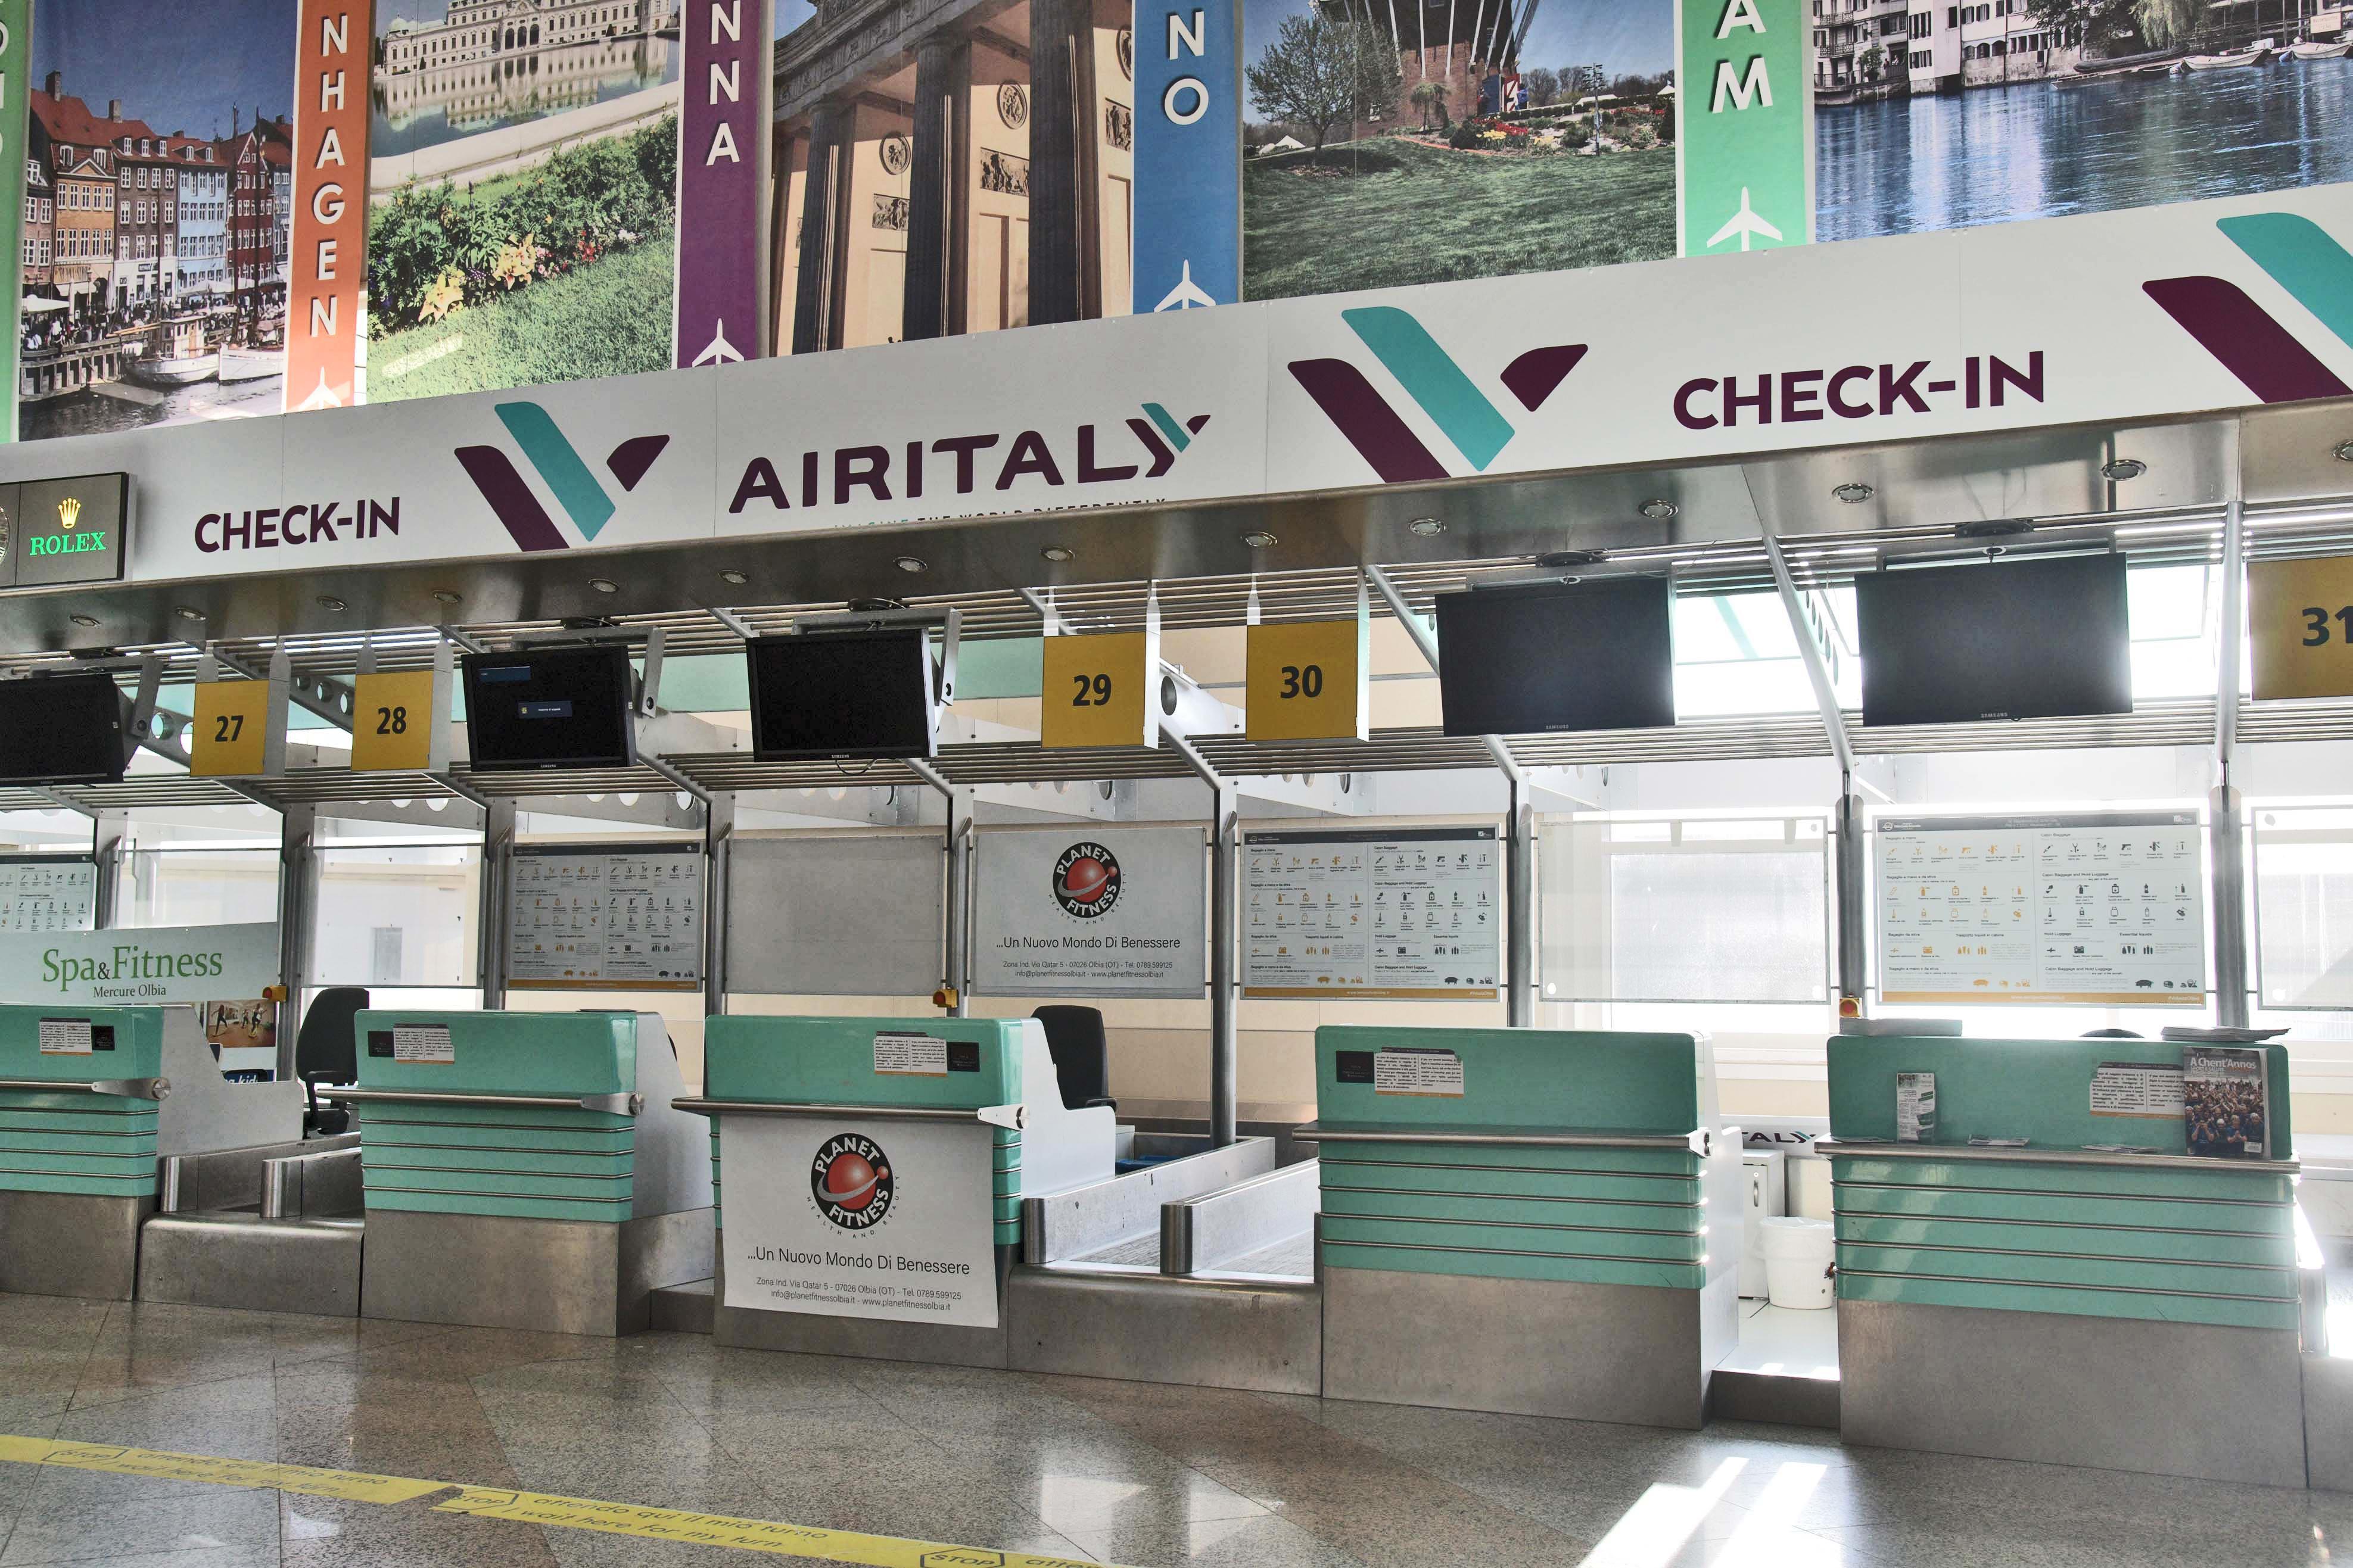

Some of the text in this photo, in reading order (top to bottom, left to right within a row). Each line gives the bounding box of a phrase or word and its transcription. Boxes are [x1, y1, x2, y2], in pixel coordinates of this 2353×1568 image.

[1164, 11, 1209, 125] NO
[1673, 351, 2044, 431] CHECK-IN
[729, 402, 1210, 513] AIRITALY
[195, 497, 400, 553] CHECK-IN
[29, 532, 106, 556] ROLEX
[1072, 674, 1112, 707] 29
[1280, 665, 1322, 699] 30
[215, 715, 244, 743] 27
[376, 707, 406, 735] 28
[1056, 845, 1110, 875] PLANET
[1066, 884, 1116, 915] FITNESS
[997, 936, 1181, 948] ...Un Nuovo Mondo Di Benessere
[43, 945, 223, 992] Spa&Fitness
[94, 984, 166, 997] Mercure Olbia
[815, 1137, 880, 1173] PLANET
[829, 1189, 888, 1226] FITNESS
[748, 1246, 969, 1274] ...Un Nuovo Mondo Di Benessere
[757, 1277, 774, 1286] Zona
[802, 1280, 821, 1290] Qatar
[835, 1283, 856, 1292] 07026
[858, 1285, 877, 1294] Olbia
[879, 1286, 895, 1296] (OT)
[917, 1289, 961, 1299] 0789.599125
[771, 1290, 855, 1304] info@planetfitnessolbia.it
[862, 1298, 951, 1311] www.planetfitnessolbia.it
[521, 1510, 574, 1520] wait
[576, 1516, 631, 1529] here
[639, 1523, 680, 1533] for
[733, 1535, 782, 1547] turn
[534, 1497, 629, 1514] attendo
[637, 1510, 681, 1520] qui
[762, 1525, 828, 1539] turno
[930, 1554, 996, 1566] STOP
